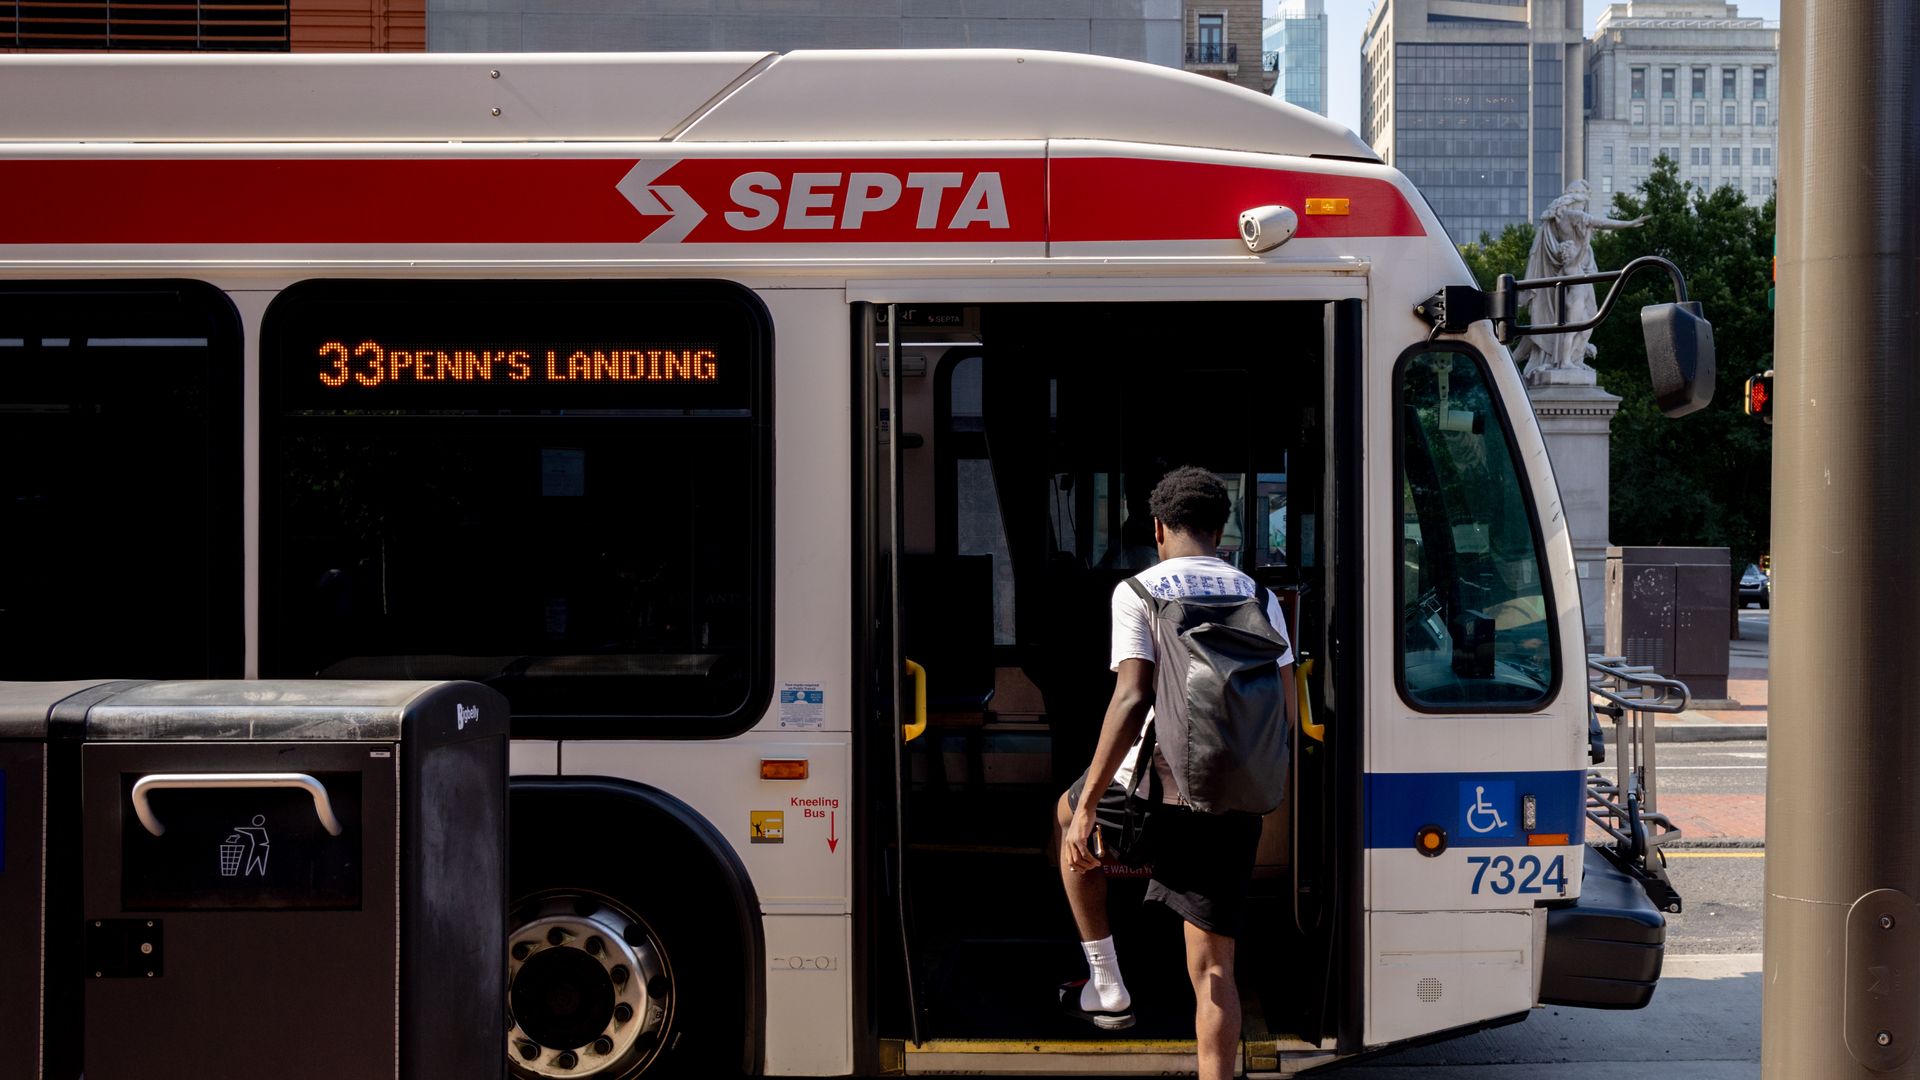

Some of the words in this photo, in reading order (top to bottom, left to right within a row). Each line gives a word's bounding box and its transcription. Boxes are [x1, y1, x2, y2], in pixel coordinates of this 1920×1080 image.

[724, 171, 1011, 231] SEPTA
[935, 315, 960, 323] SEPTA
[319, 342, 384, 386] 33
[390, 351, 531, 380] PENN'S
[547, 351, 717, 380] LANDING
[790, 797, 839, 808] Kneeling
[804, 809, 826, 818] Bus
[1467, 855, 1568, 895] 7324
